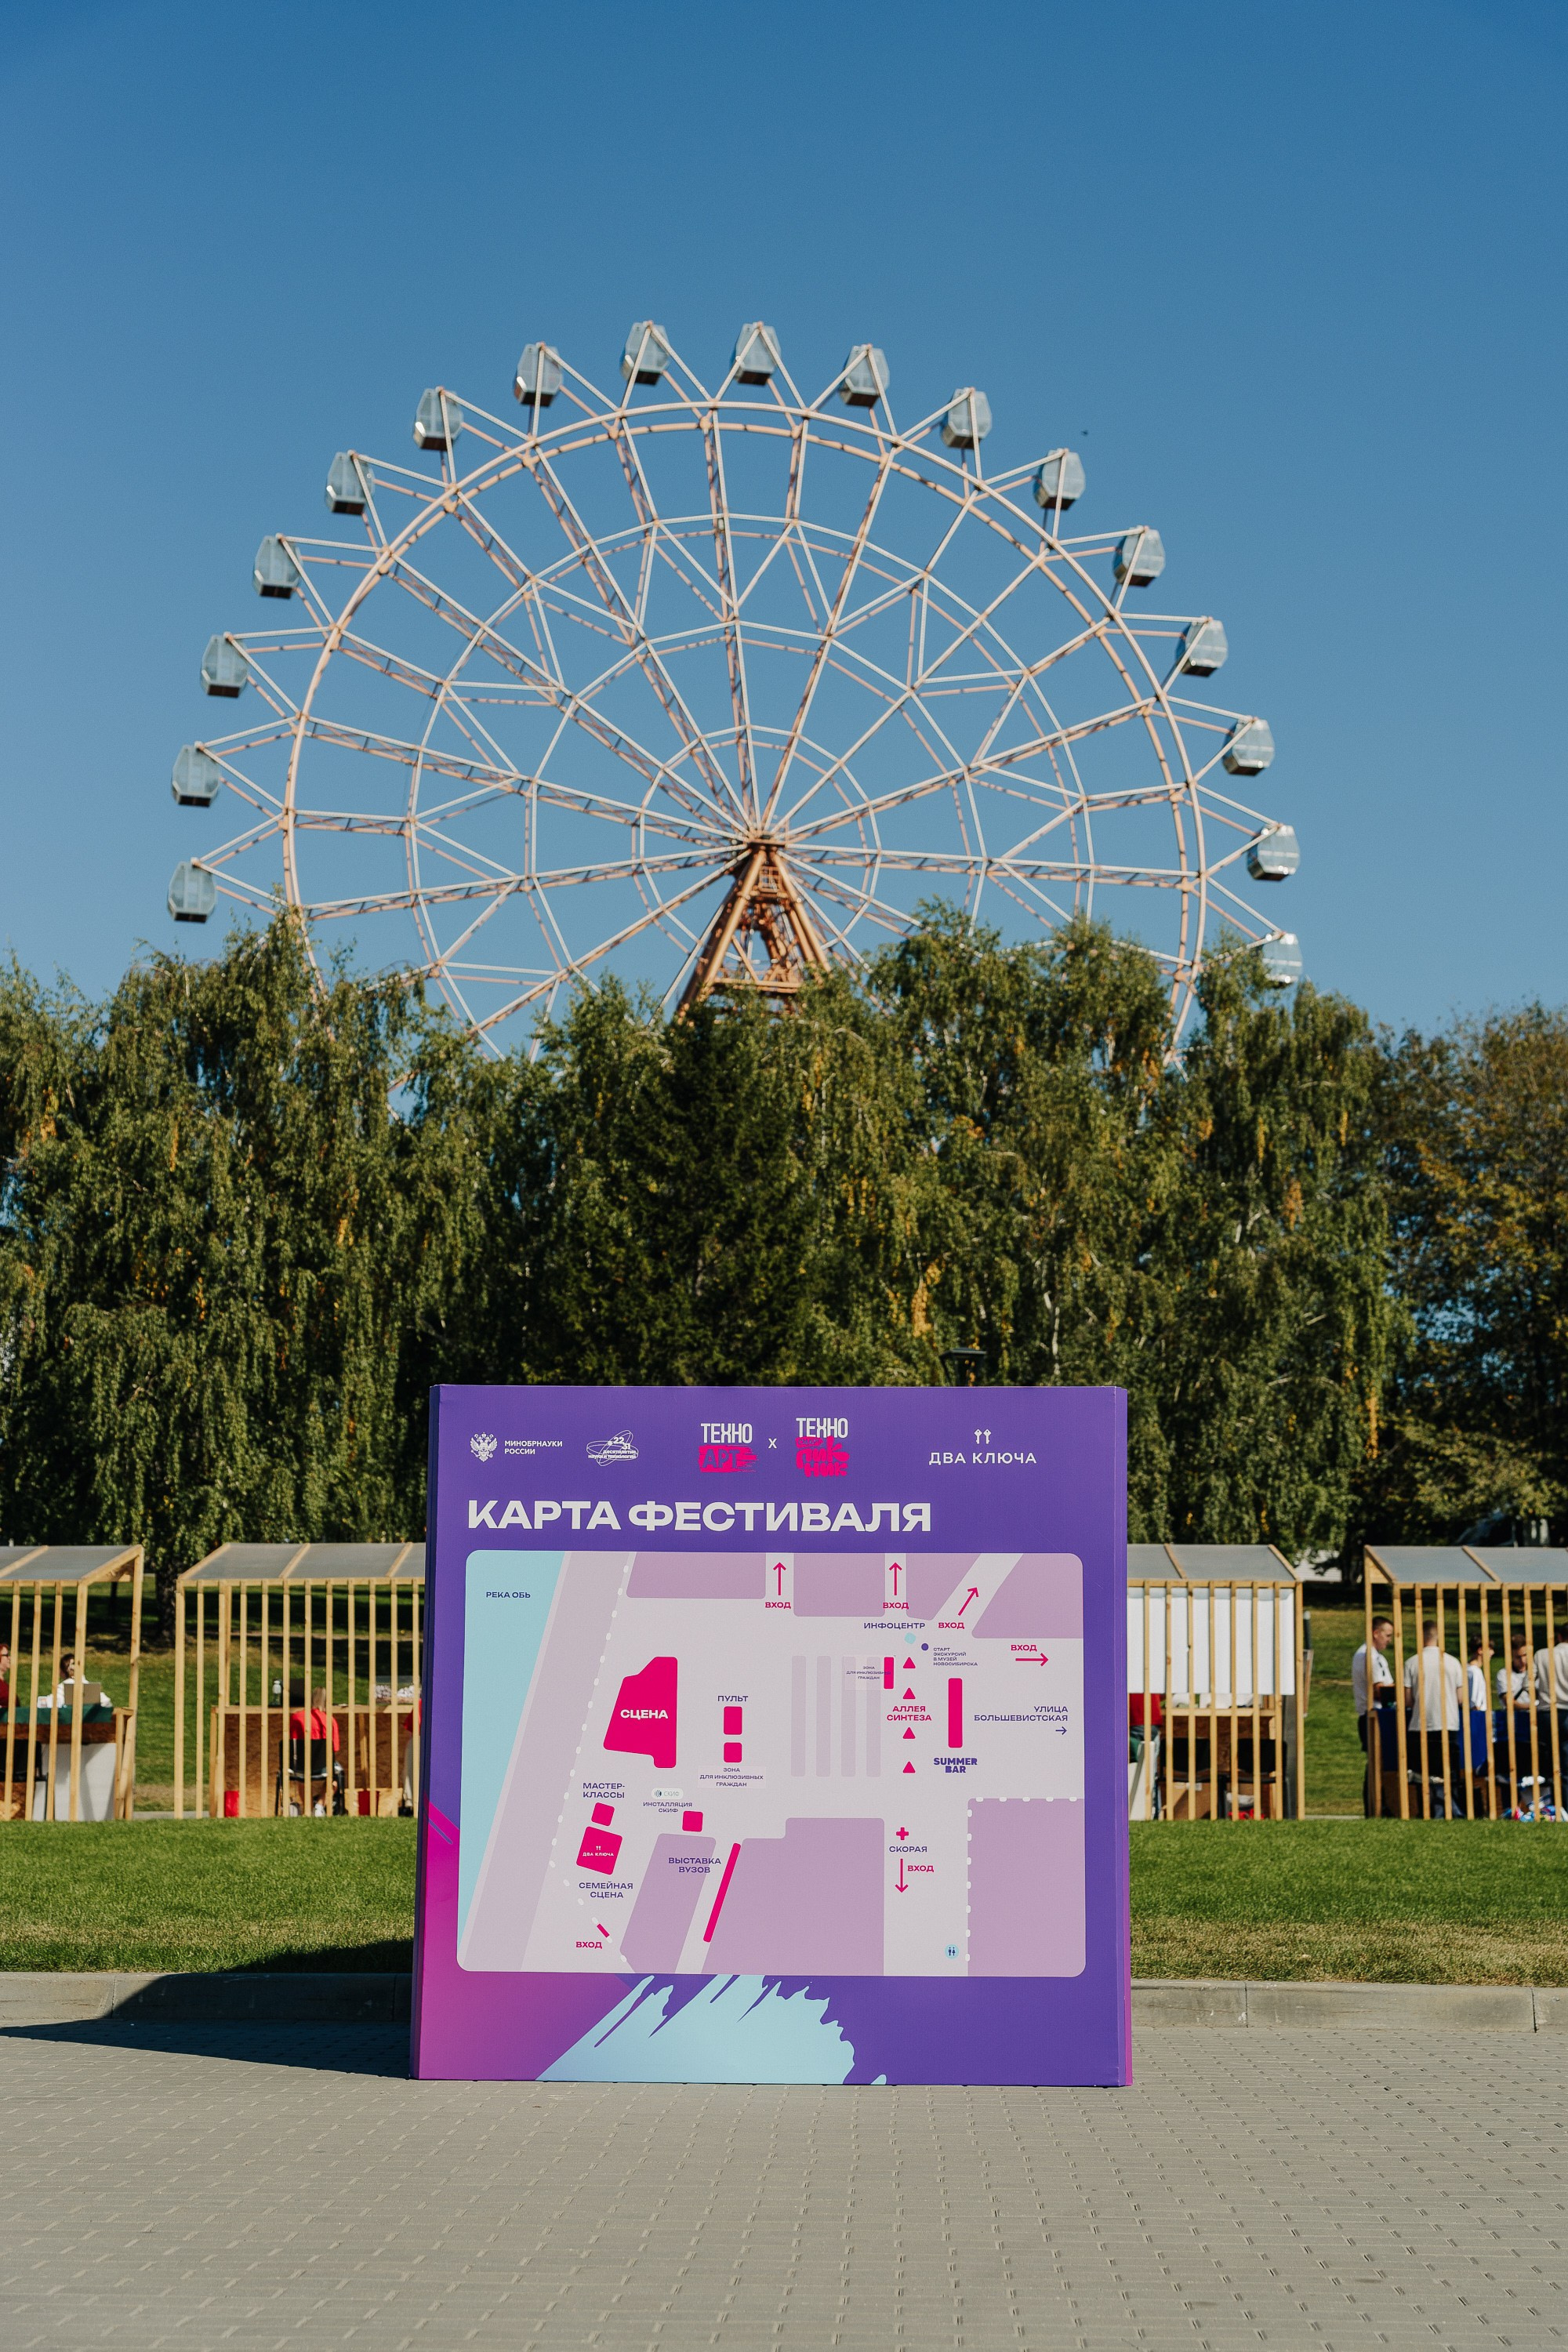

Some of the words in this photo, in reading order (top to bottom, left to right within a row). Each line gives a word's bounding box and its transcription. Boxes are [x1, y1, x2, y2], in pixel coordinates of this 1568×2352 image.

[796, 1417, 848, 1439] ТЕХНО
[700, 1422, 753, 1444] ТЕХНО
[928, 1452, 967, 1466] ДВА
[971, 1451, 1037, 1465] КЛЮЧА
[468, 1499, 622, 1530] КАРТА
[628, 1501, 931, 1533] ФЕСТИВАЛЯ
[938, 1621, 965, 1630] ВХОД
[1011, 1644, 1038, 1653] ВХОД
[619, 1708, 669, 1721] СЦЕНА
[933, 1757, 978, 1766] SUMMER
[945, 1765, 967, 1773] BAR
[907, 1864, 935, 1873] ВХОД
[579, 1881, 633, 1889] СЕМЕЙНАЯ
[575, 1941, 603, 1950] ВХОД
